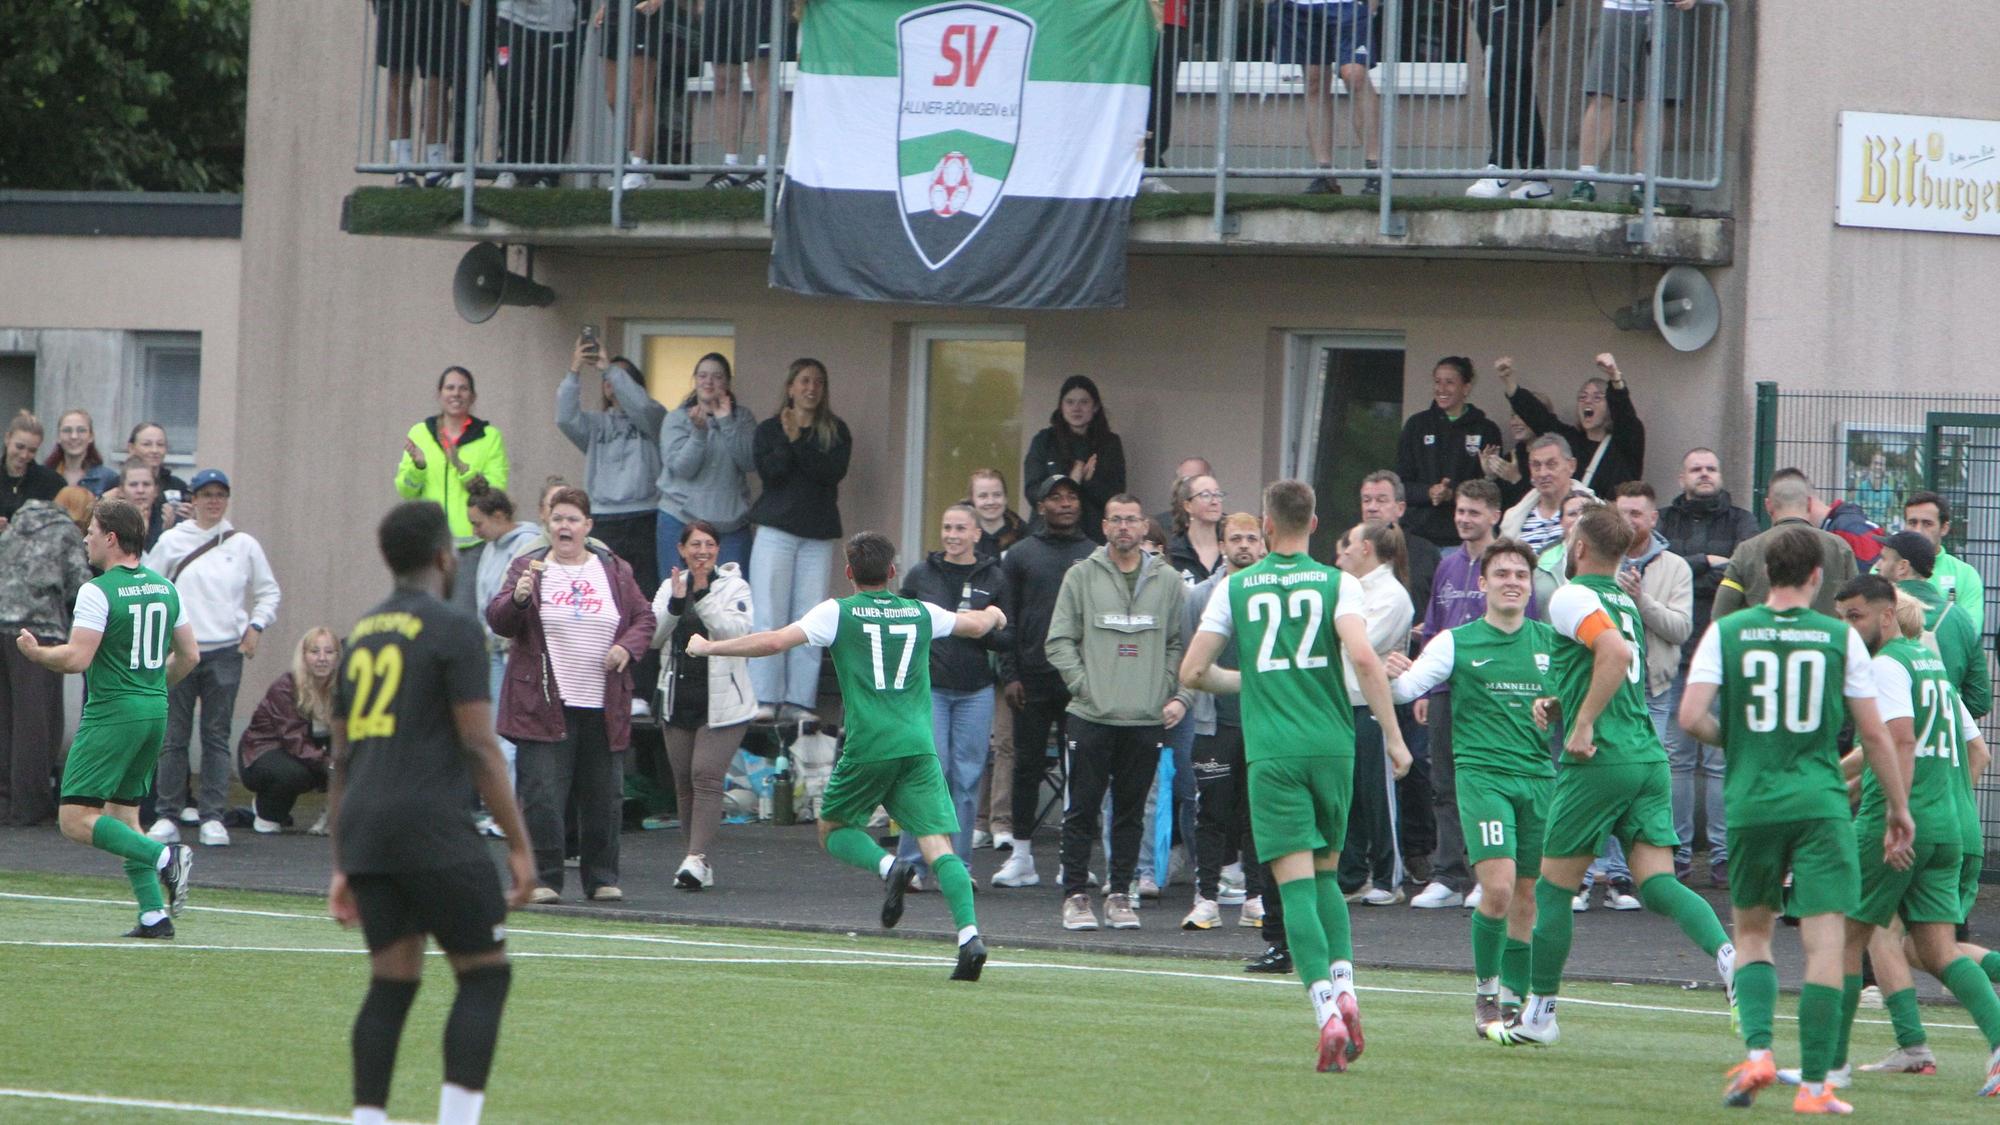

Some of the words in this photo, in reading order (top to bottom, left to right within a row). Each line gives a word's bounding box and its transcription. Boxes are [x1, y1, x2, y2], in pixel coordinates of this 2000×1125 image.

[932, 25, 999, 87] SV
[902, 99, 999, 116] ALLNER-BÖDINGEN
[128, 602, 168, 670] 10
[862, 623, 917, 690] 17
[1247, 589, 1328, 673] 22
[346, 643, 403, 742] 22
[1484, 682, 1543, 692] MANNELLA
[1743, 650, 1827, 733] 30
[1479, 820, 1504, 847] 18
